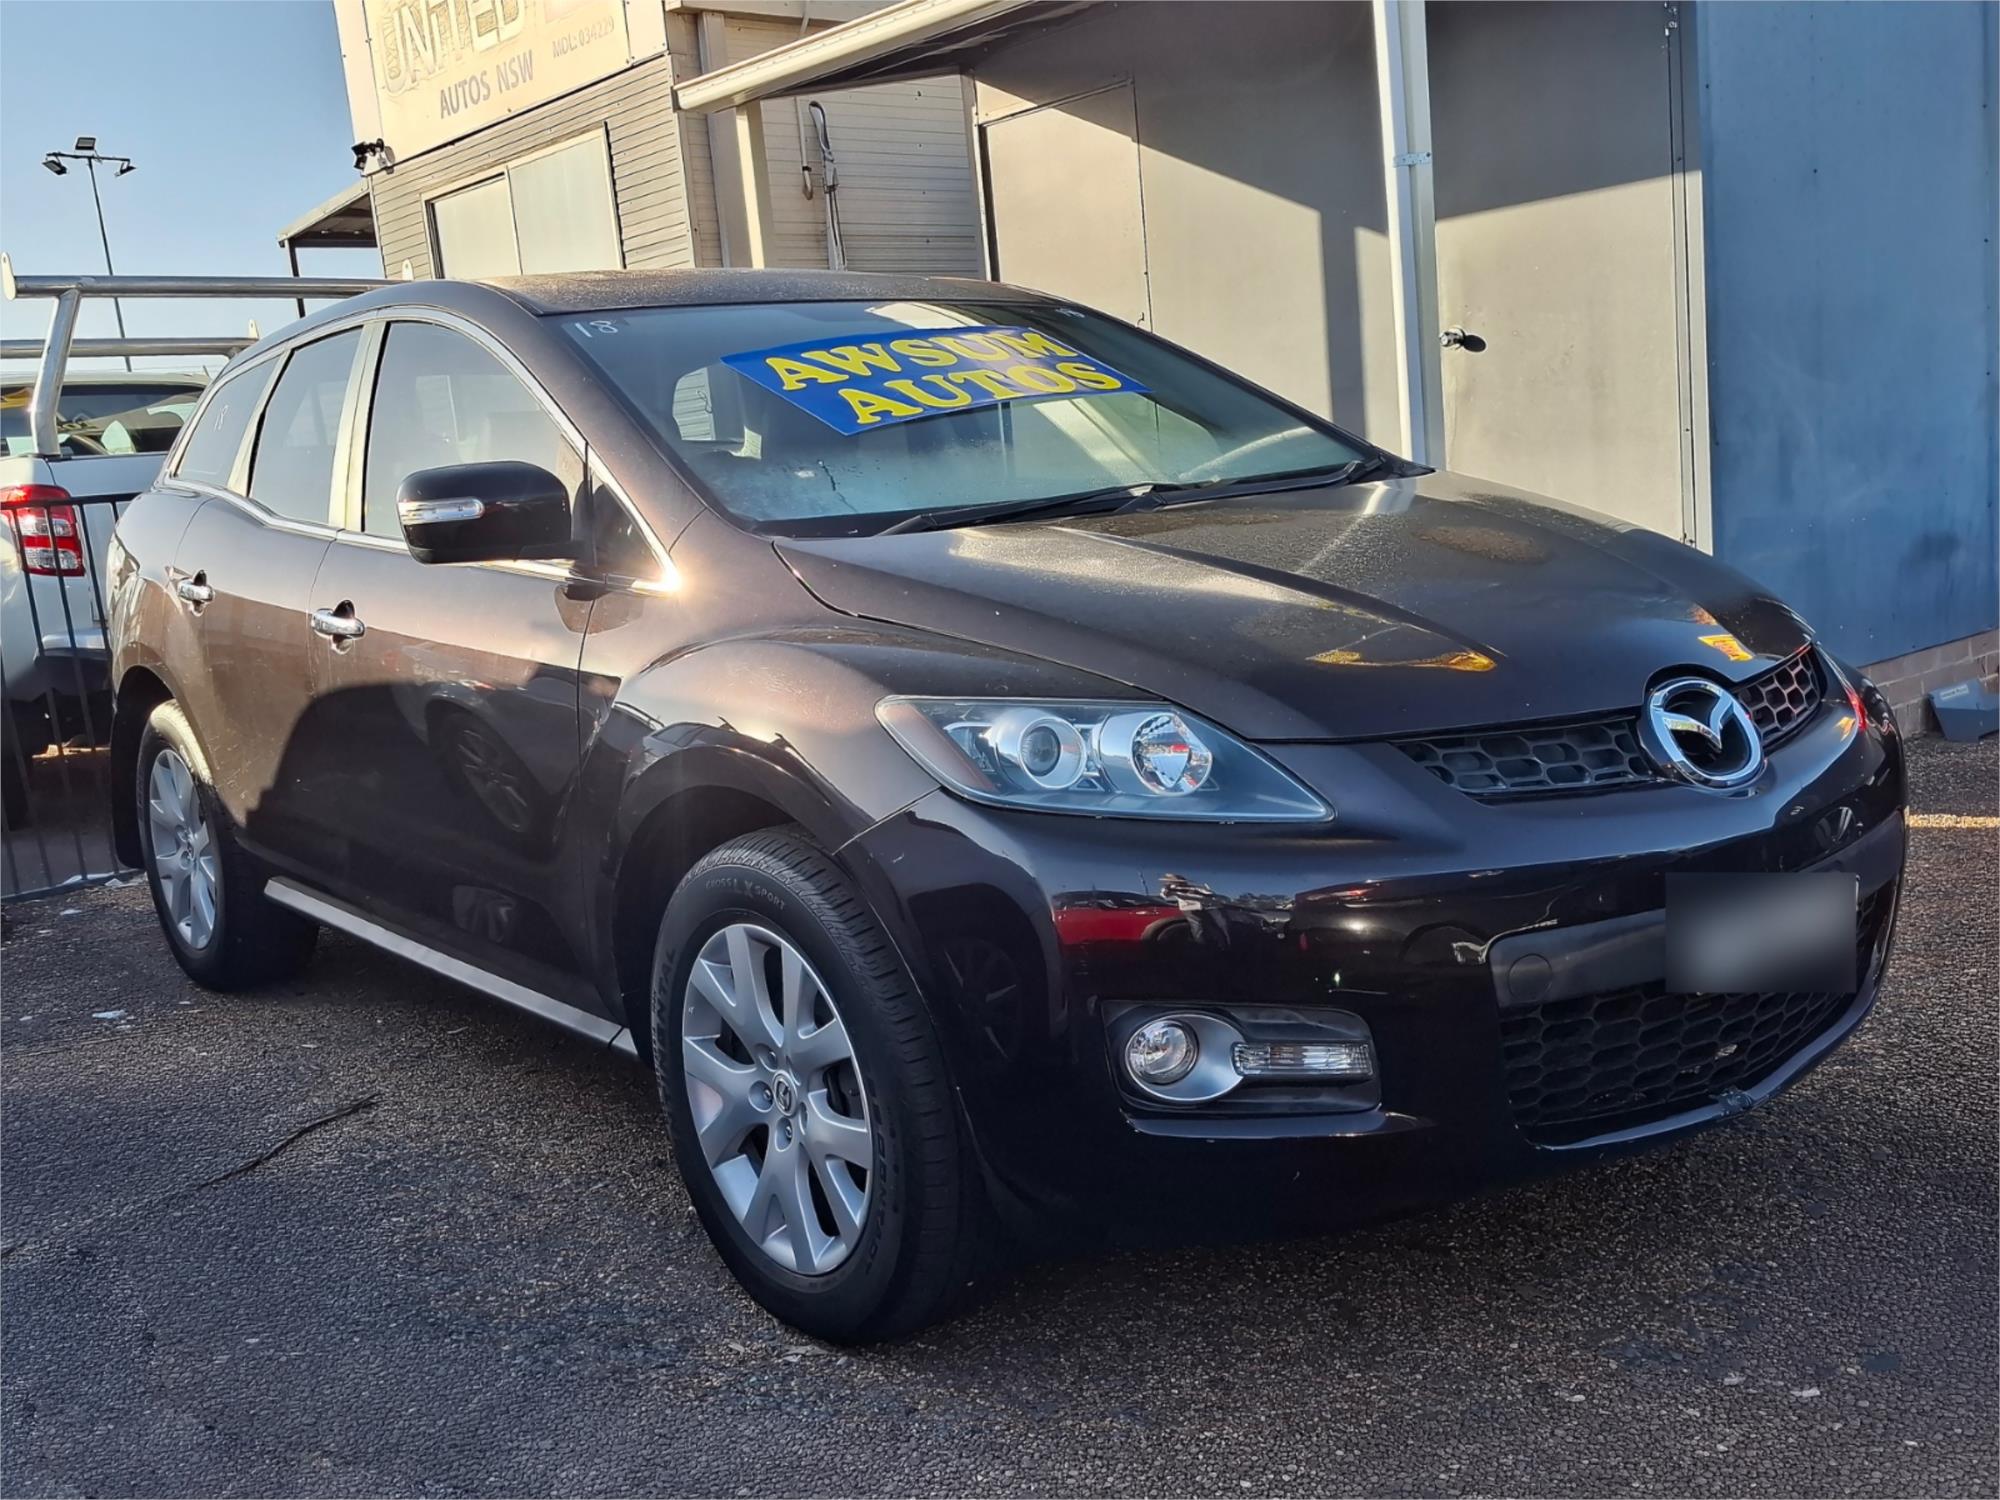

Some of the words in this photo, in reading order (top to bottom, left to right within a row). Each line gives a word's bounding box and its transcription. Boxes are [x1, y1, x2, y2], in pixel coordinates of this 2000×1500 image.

[440, 70, 491, 119] AUTOS
[496, 49, 534, 94] NSW
[574, 320, 618, 337] 18
[764, 332, 1079, 391] AWSUM
[837, 361, 1122, 424] AUTOS
